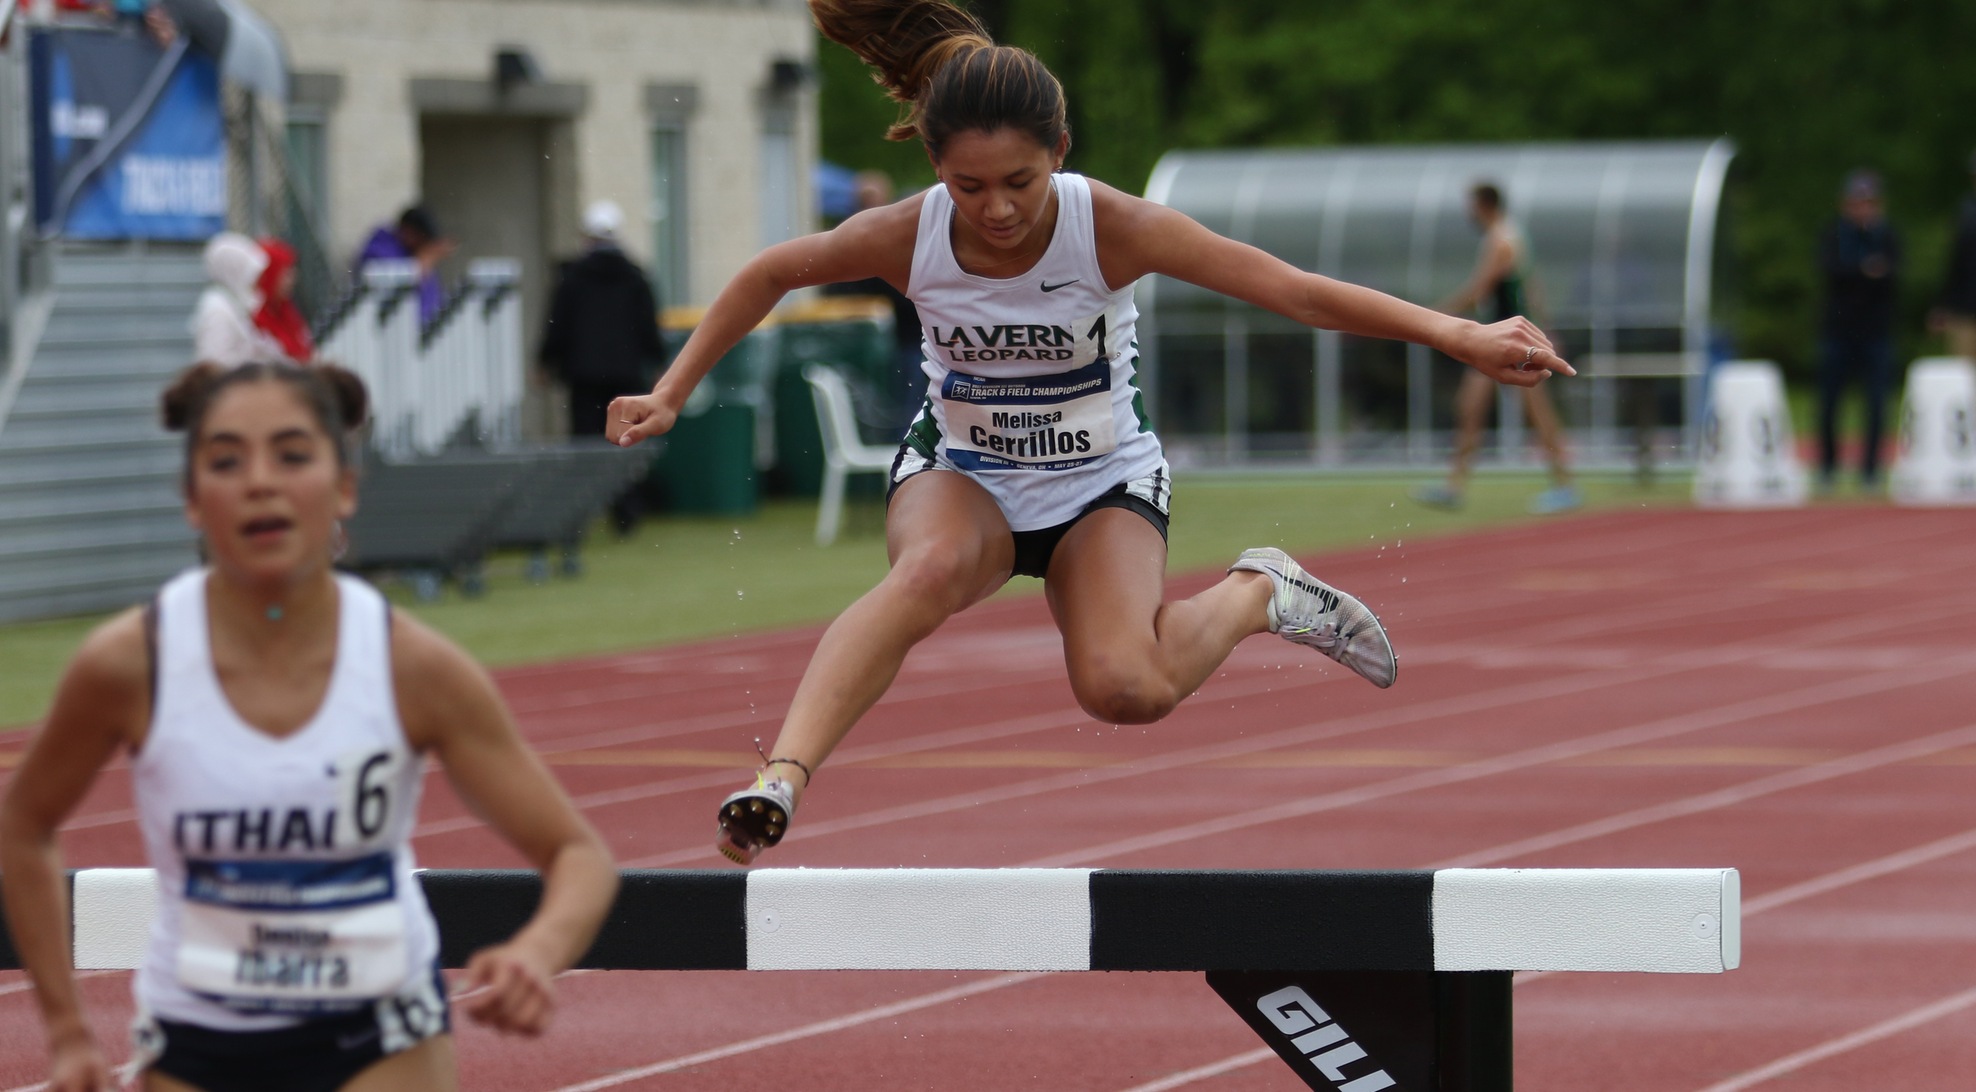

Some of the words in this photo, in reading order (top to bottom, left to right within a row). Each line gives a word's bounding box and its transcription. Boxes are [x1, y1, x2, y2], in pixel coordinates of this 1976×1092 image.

[932, 326, 975, 348] LA
[971, 388, 999, 397] TRACK
[999, 388, 1007, 397] &
[1007, 387, 1031, 397] FIELD
[1032, 378, 1102, 396] CHAMPIONSHIPS
[992, 410, 1062, 429] Melissa
[969, 425, 1091, 457] Cerrillos
[979, 455, 1003, 465] DIVISION
[355, 751, 392, 838] 6
